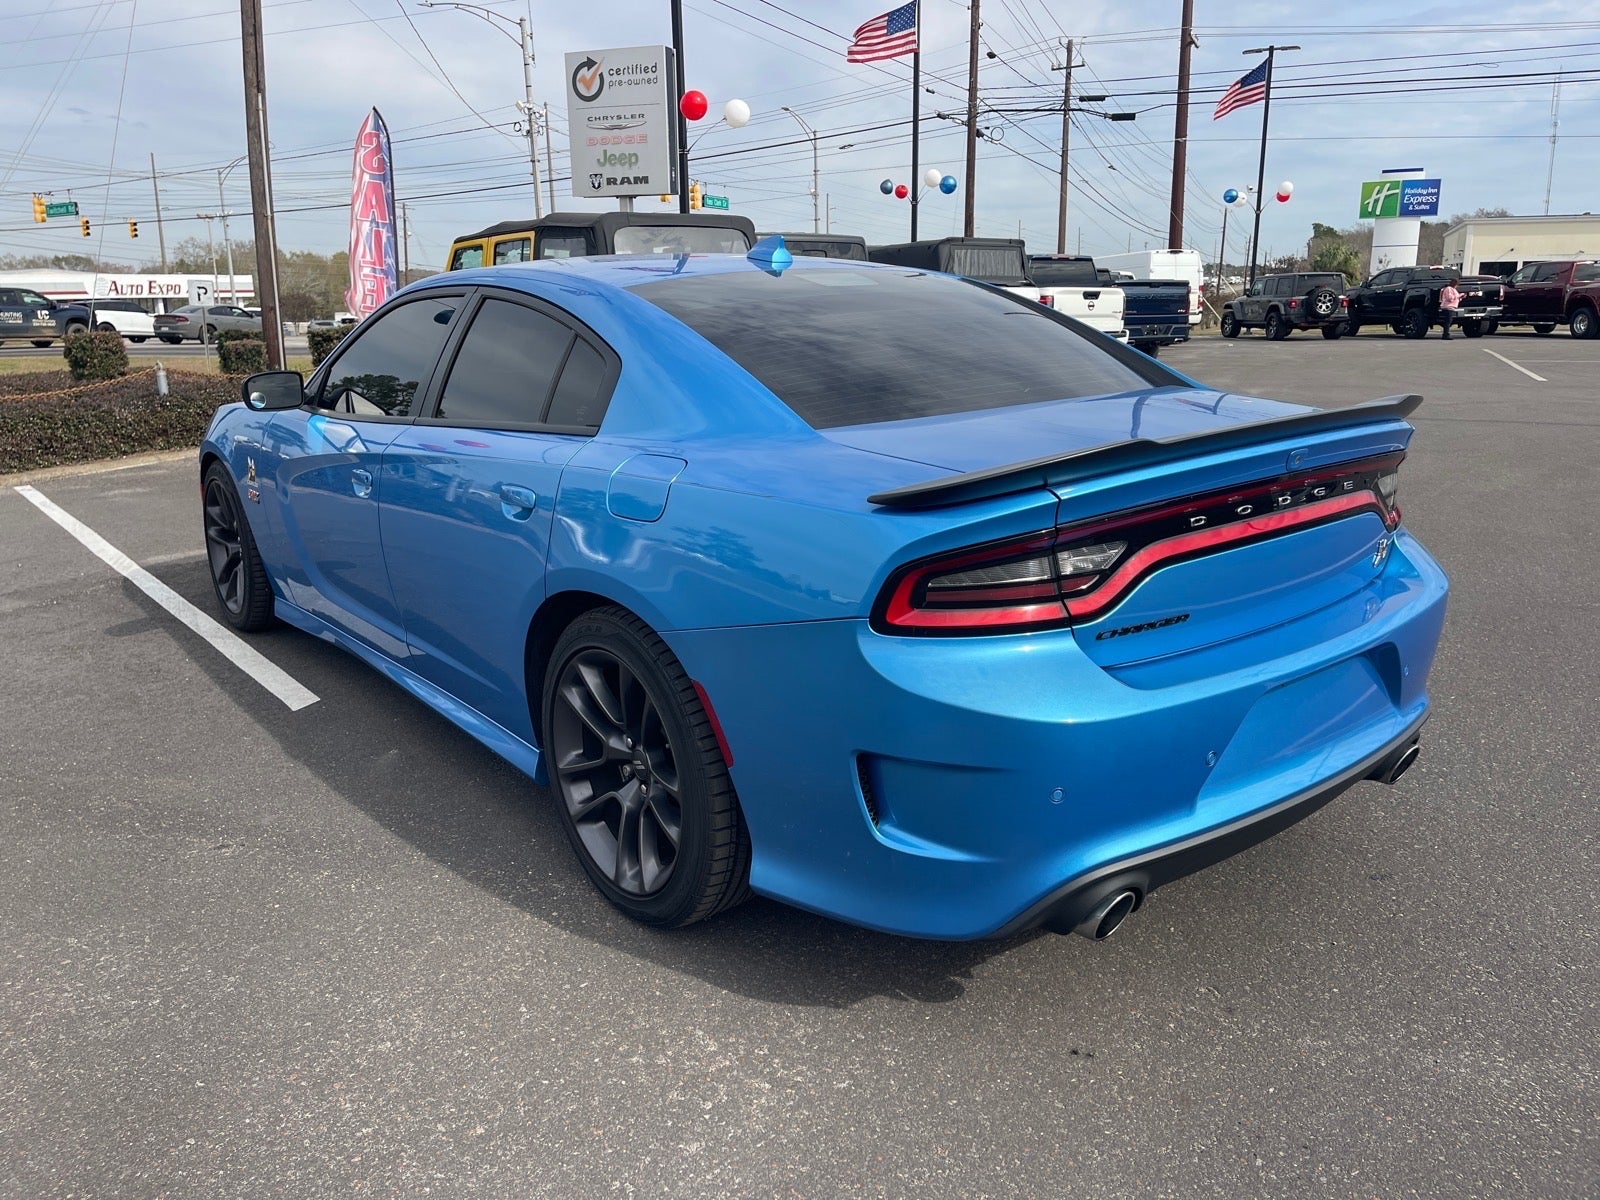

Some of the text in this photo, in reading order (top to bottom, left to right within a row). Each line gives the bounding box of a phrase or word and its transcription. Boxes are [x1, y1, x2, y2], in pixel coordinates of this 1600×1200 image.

[608, 62, 658, 76] certified
[608, 75, 658, 90] pre-owned
[587, 113, 646, 122] CHRYSLER
[586, 133, 648, 147] DODGE
[596, 149, 639, 168] Jeep
[606, 175, 649, 186] RAM
[1404, 187, 1427, 195] Holiday
[1404, 195, 1438, 204] Express
[107, 280, 181, 296] AUTO EXPO
[1190, 481, 1354, 527] DODGE
[1096, 613, 1191, 640] CHARGER
